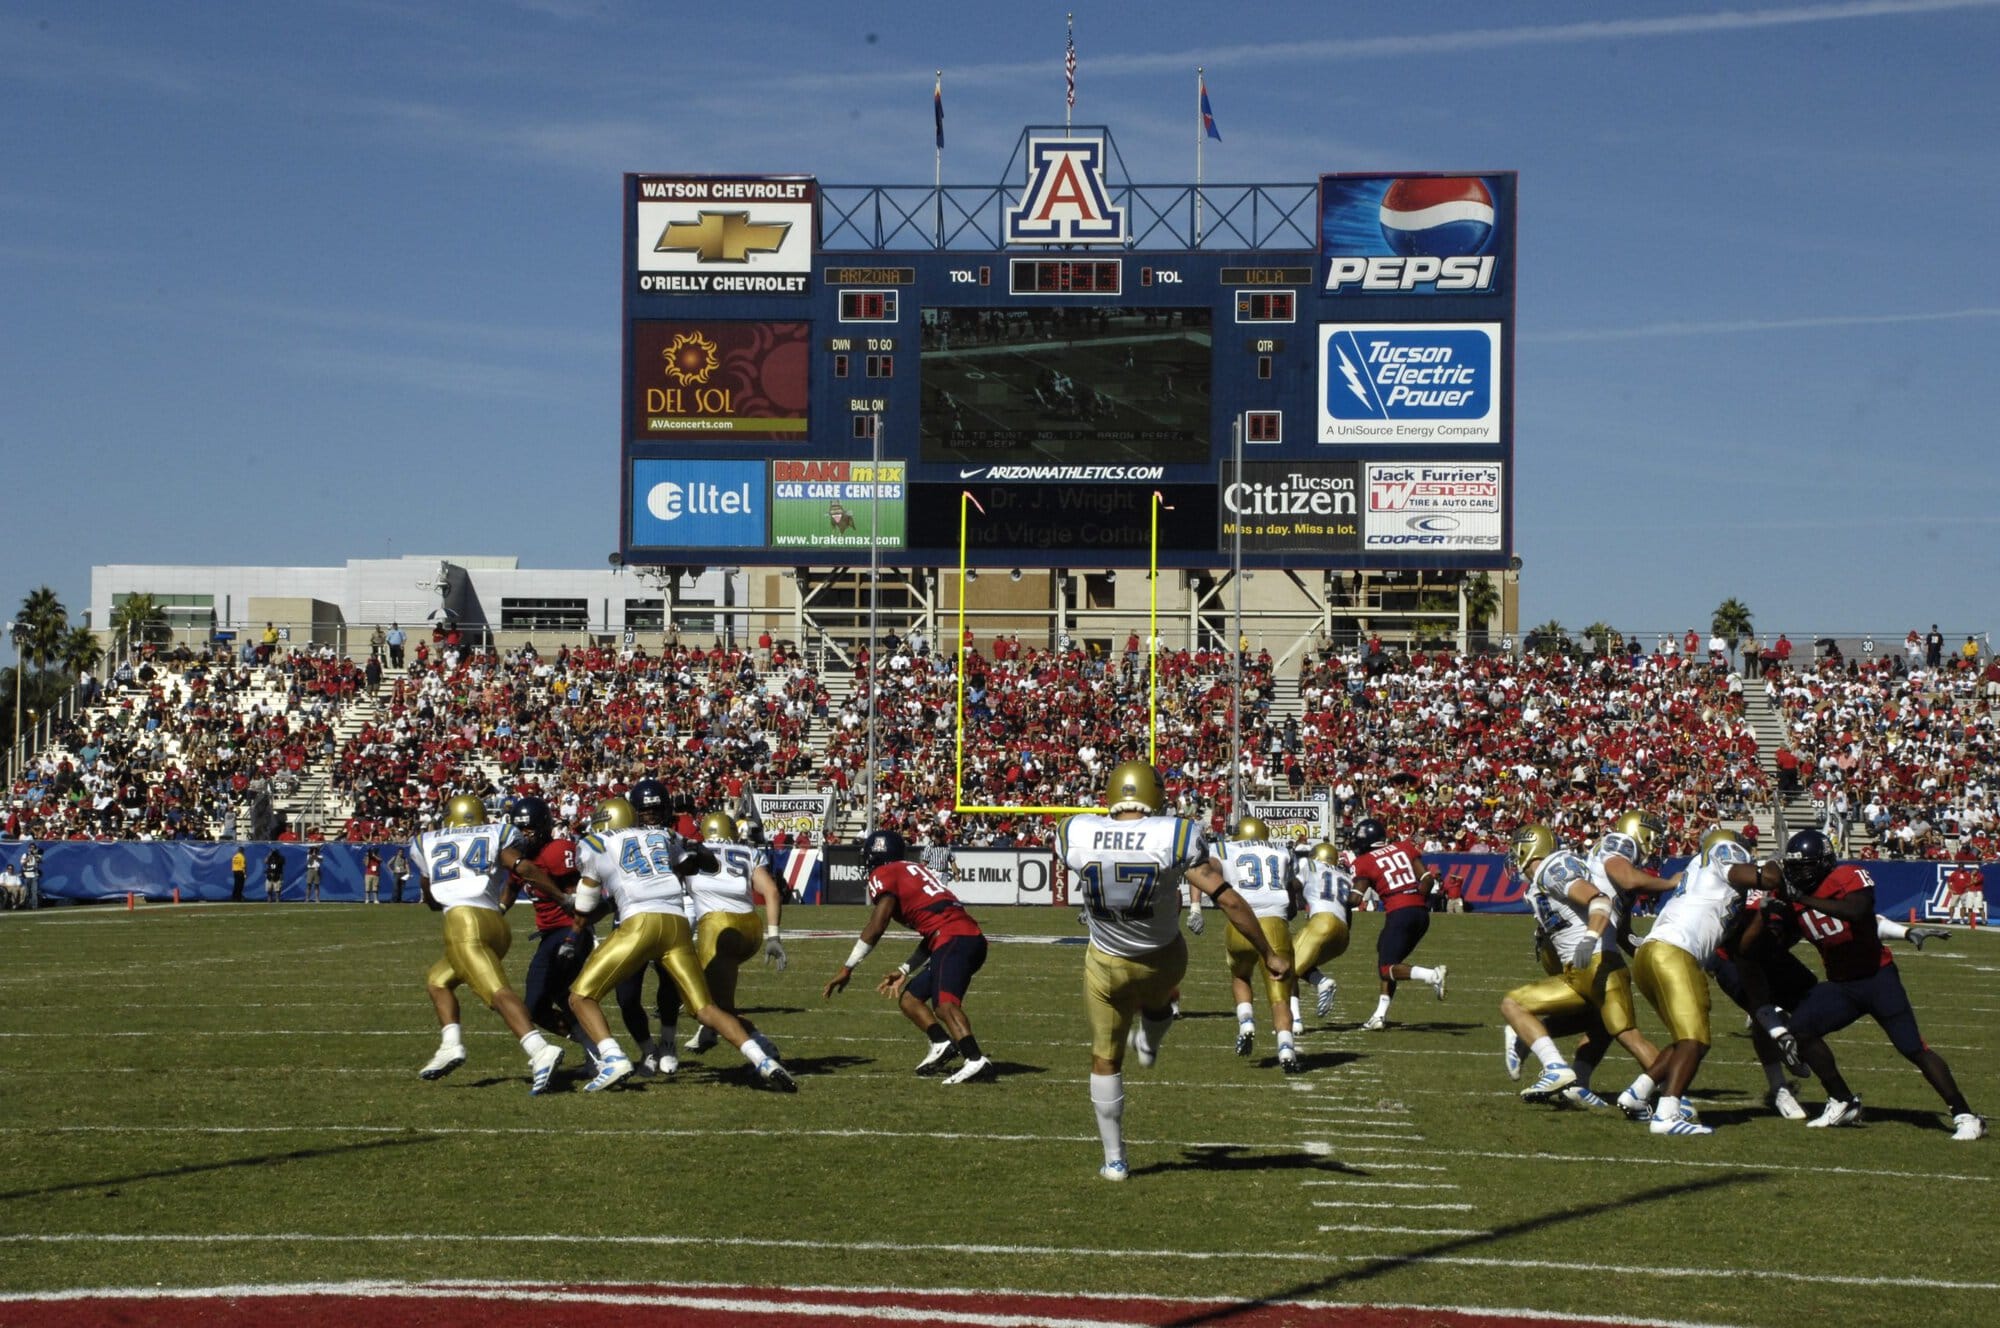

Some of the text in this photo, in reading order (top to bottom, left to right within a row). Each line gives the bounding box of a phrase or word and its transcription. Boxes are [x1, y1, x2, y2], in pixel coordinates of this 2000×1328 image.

[642, 183, 806, 198] WATSON CHEVROLET
[1006, 137, 1125, 243] A
[839, 268, 901, 283] ARIZONA
[949, 271, 976, 283] TOL
[1156, 271, 1183, 283] TOL
[1246, 270, 1284, 284] UCLA
[1325, 255, 1496, 291] PEPSI
[640, 275, 806, 291] O'RIELLY CHEVROLET
[832, 339, 850, 351] DWN
[867, 339, 892, 351] TO GO
[1257, 340, 1273, 352] QTR
[1368, 341, 1453, 363] Tucson
[1376, 364, 1475, 385] Electric
[647, 388, 735, 413] DEL SOL
[1385, 385, 1475, 407] Power
[851, 399, 884, 411] BALL ON
[650, 419, 733, 431] AVAconcerts.com
[1326, 425, 1490, 437] A UniSource Energy Company
[775, 461, 850, 482] BRAKE
[986, 466, 1164, 480] ARIZONAATHLETICS.COM
[1372, 469, 1497, 483] Jack Furrier's
[1288, 473, 1354, 490] Tucson
[776, 484, 803, 498] CAR
[807, 484, 841, 498] CARE
[1372, 482, 1497, 510] WESTERN
[647, 481, 752, 521] alltel
[991, 488, 1022, 509] Dr.
[1056, 487, 1136, 513] Wright
[1224, 482, 1358, 515] Citizen
[1410, 499, 1430, 508] TIRE
[1442, 499, 1467, 508] AUTO
[1469, 499, 1494, 508] CARE
[1002, 524, 1073, 547] Virgie
[1255, 526, 1263, 535] a
[1266, 524, 1291, 537] day.
[1294, 524, 1324, 535] Miss
[1326, 526, 1334, 535] a
[1337, 525, 1357, 535] lot.
[776, 534, 901, 546] www.brakemax.com
[278, 629, 288, 639] 26
[625, 633, 634, 644] 27
[1059, 635, 1070, 647] 28
[1502, 638, 1512, 650] 29
[1862, 640, 1874, 652] 30
[274, 781, 288, 790] 26
[821, 786, 834, 794] 28
[1313, 793, 1327, 801] 29
[1811, 800, 1825, 808] 30
[762, 800, 824, 813] BRUEGGER'S
[1256, 807, 1319, 820] BRUEGGER'S
[1093, 831, 1147, 851] PEREZ
[431, 837, 491, 885] 24
[619, 833, 674, 878] 42
[978, 867, 1012, 882] MILK
[1236, 853, 1285, 891] 31
[1375, 851, 1417, 890] 29
[906, 863, 948, 898] 3
[1854, 869, 1875, 888] 15
[1081, 861, 1160, 922] 17
[1801, 909, 1844, 941] 15
